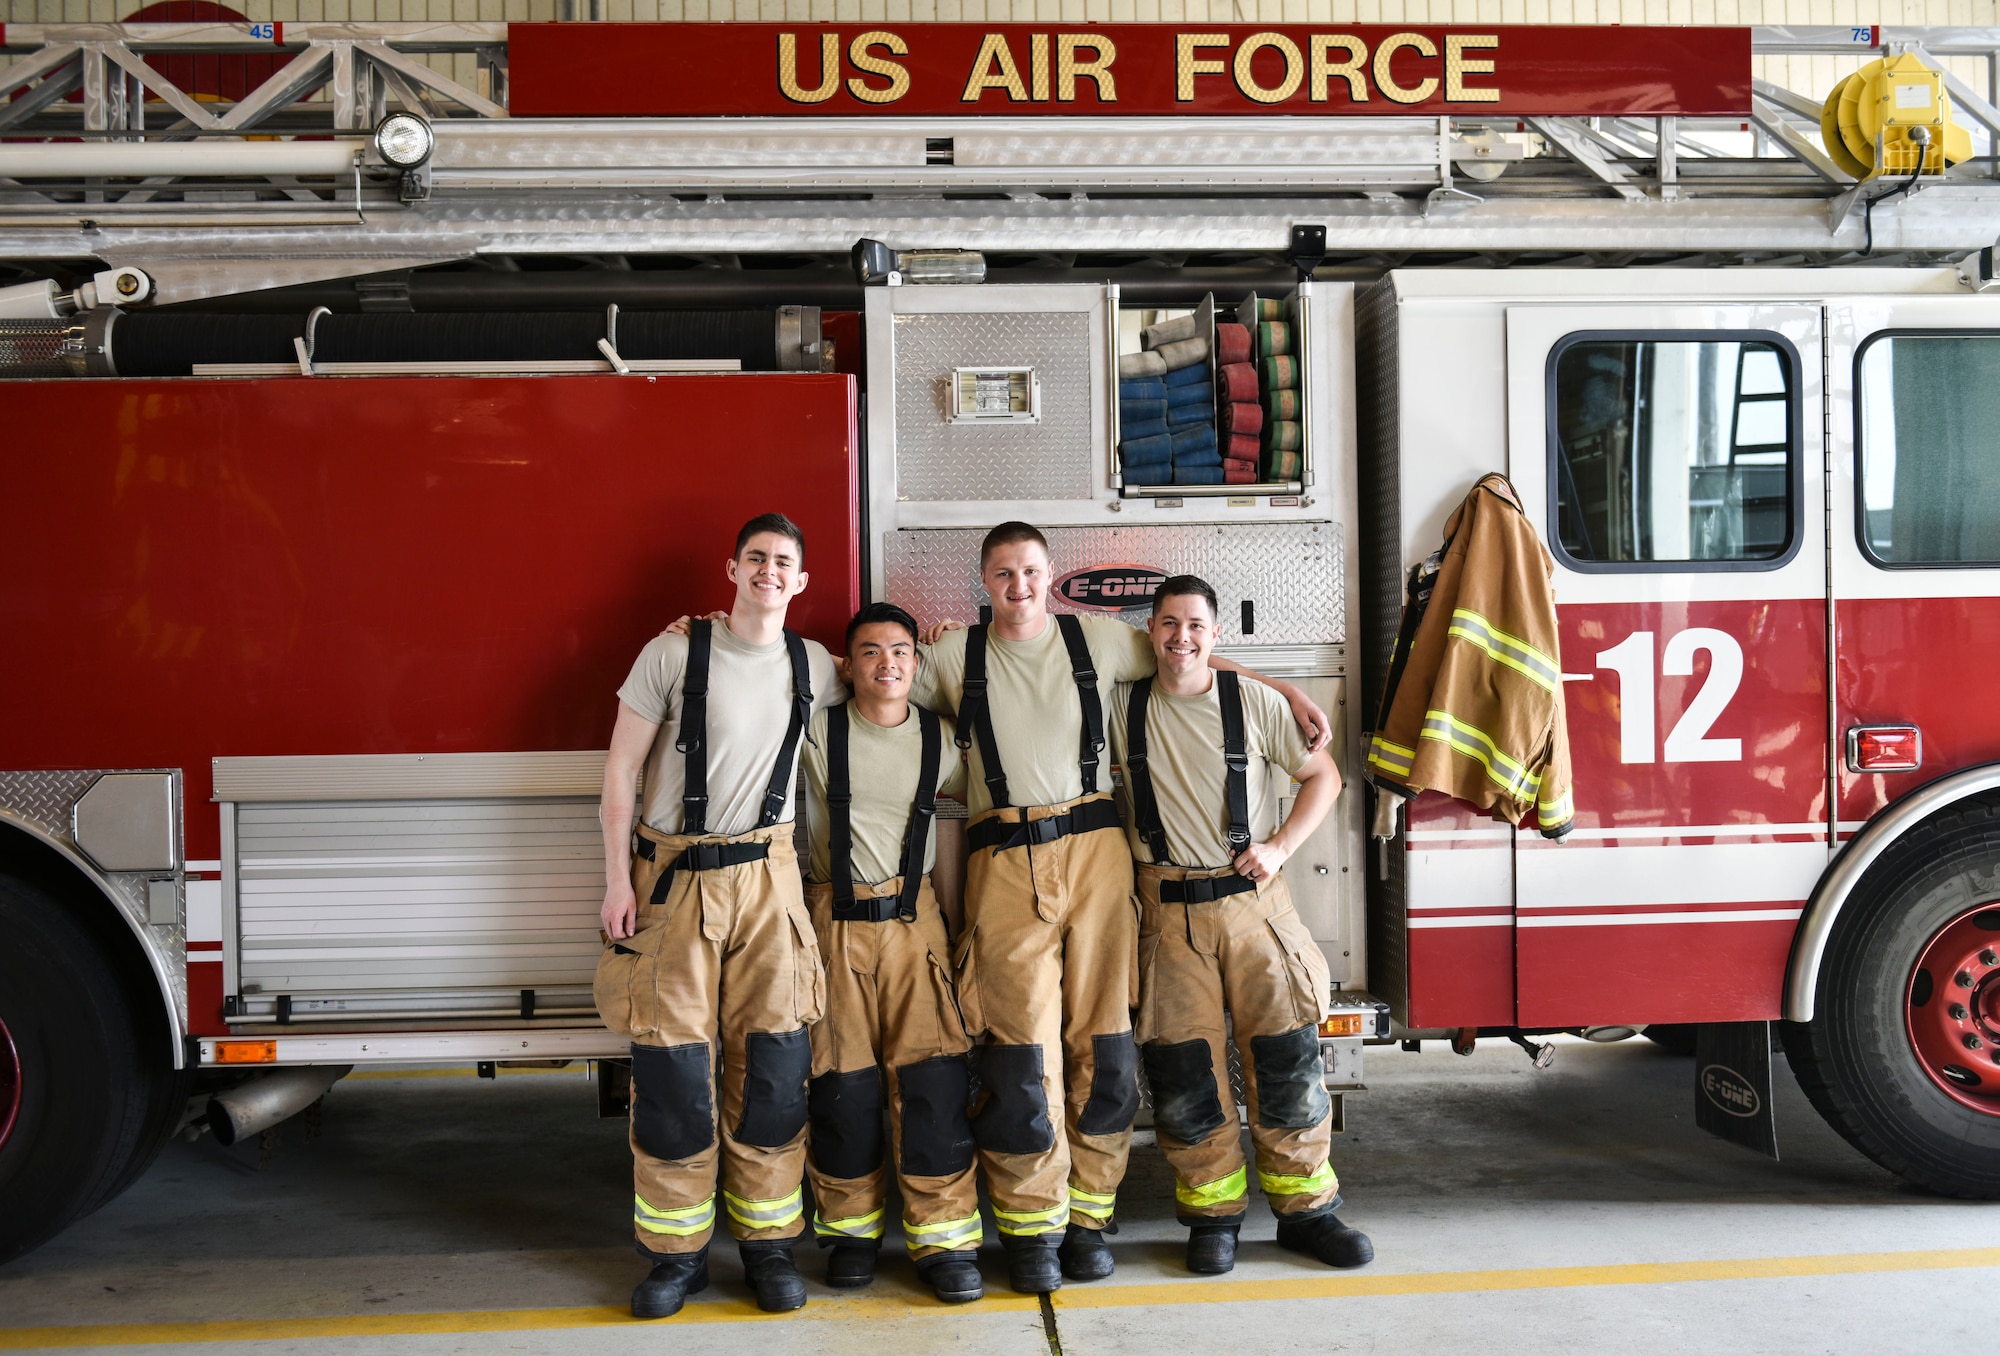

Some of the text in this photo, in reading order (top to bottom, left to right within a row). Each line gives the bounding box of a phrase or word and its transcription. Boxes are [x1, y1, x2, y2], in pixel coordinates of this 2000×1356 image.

[250, 24, 273, 39] 45
[1851, 28, 1871, 42] 75
[777, 31, 1501, 104] US AIR FORCE
[1595, 627, 1744, 764] 12
[1706, 1072, 1753, 1109] E-ONE
